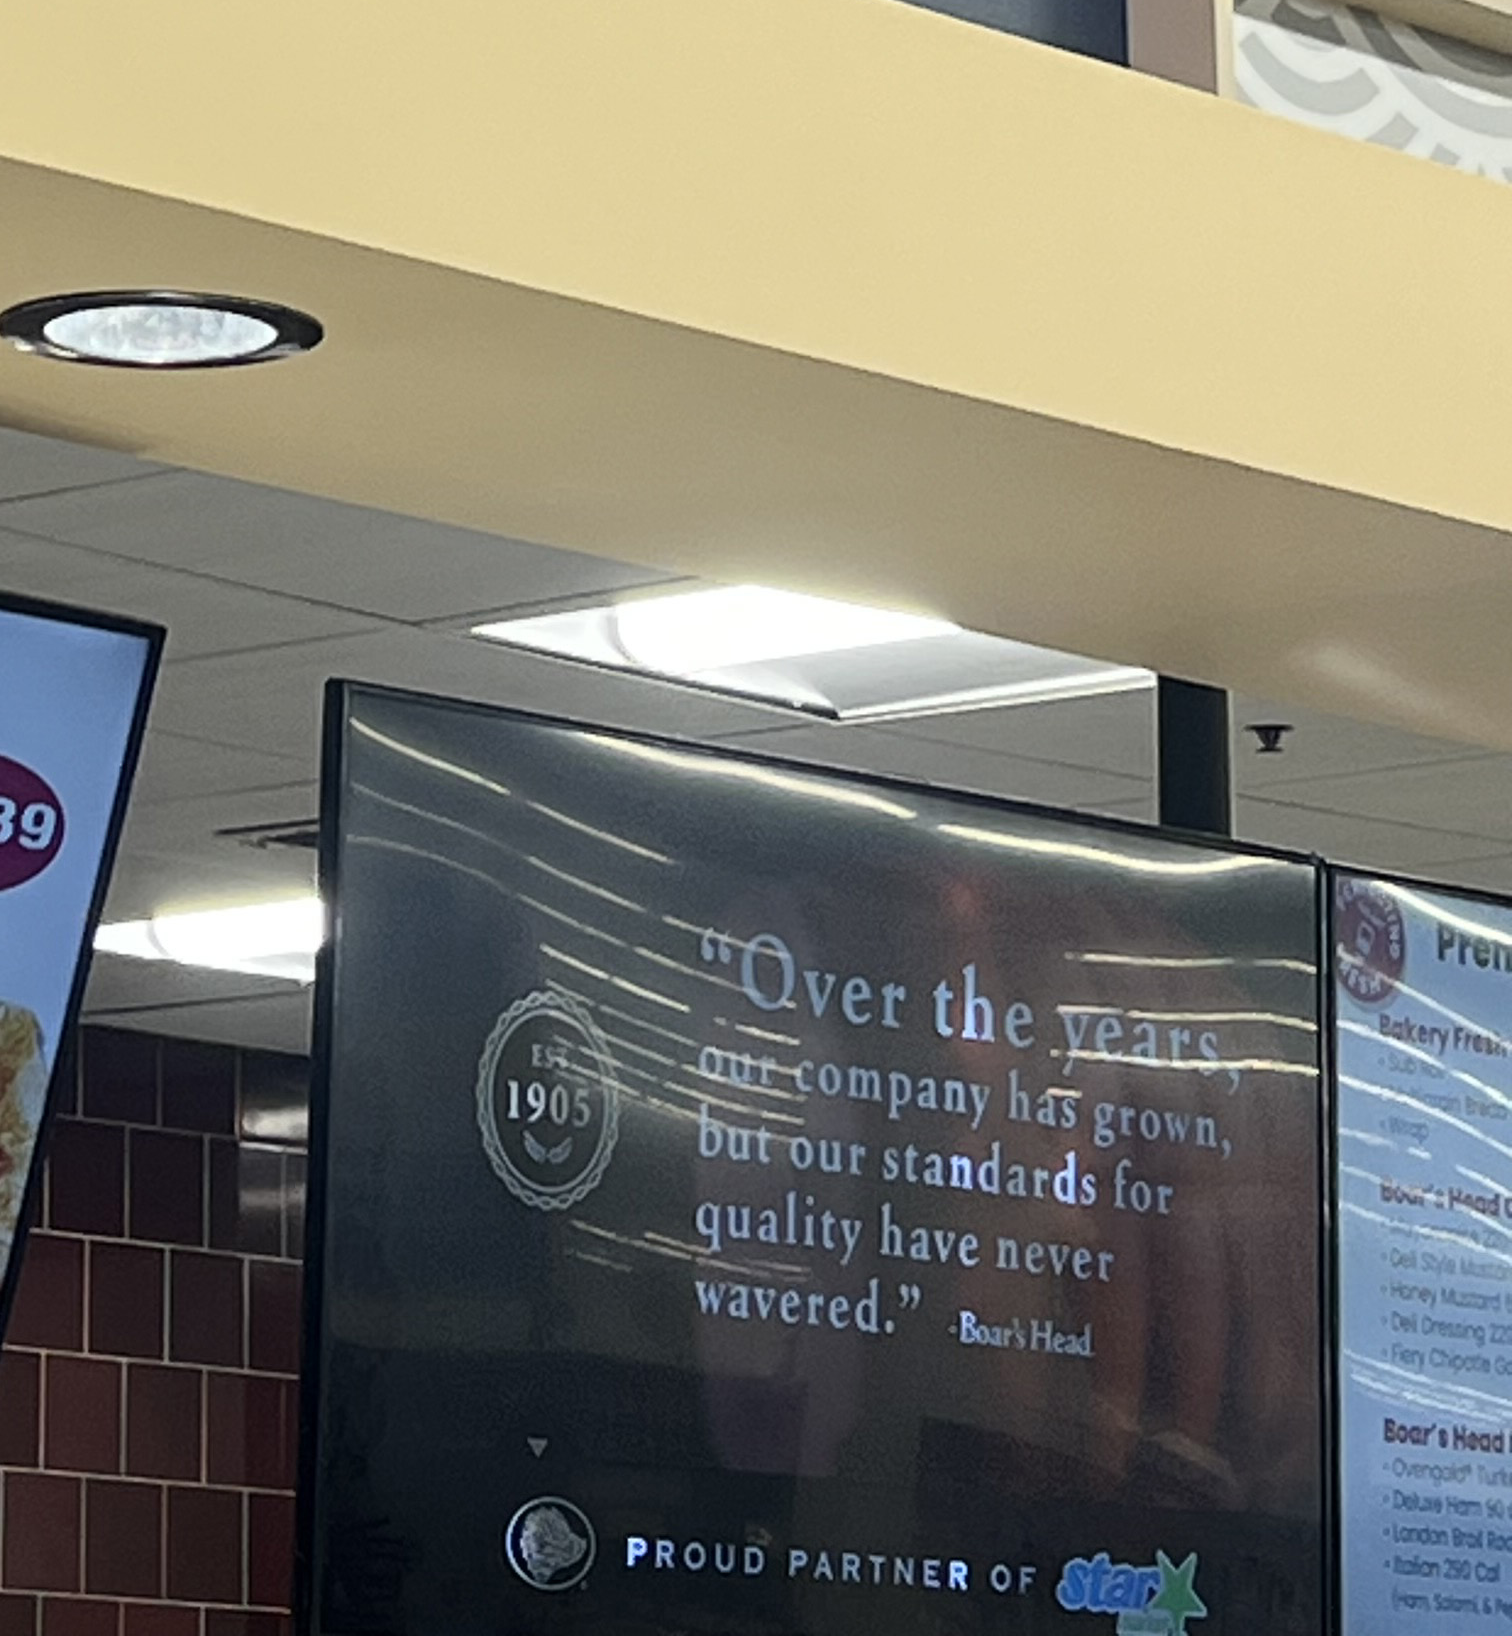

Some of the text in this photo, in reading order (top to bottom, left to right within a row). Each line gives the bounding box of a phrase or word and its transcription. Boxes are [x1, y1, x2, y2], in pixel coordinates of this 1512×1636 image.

[932, 964, 1035, 1048] the
[1061, 1008, 1242, 1095] years,
[1379, 1012, 1449, 1056] Bakery
[506, 1078, 591, 1128] 1905
[698, 1045, 1232, 1160] our company has grown,
[698, 1102, 1175, 1216] but our standards for
[695, 1192, 1116, 1283] quality have never
[695, 1278, 922, 1335] wavered.”
[1031, 1320, 1095, 1359] Head
[1383, 1417, 1504, 1453] Boar's Head
[625, 1536, 766, 1576] PROUD
[790, 1549, 970, 1593] PARTNER
[990, 1565, 1037, 1594] OF
